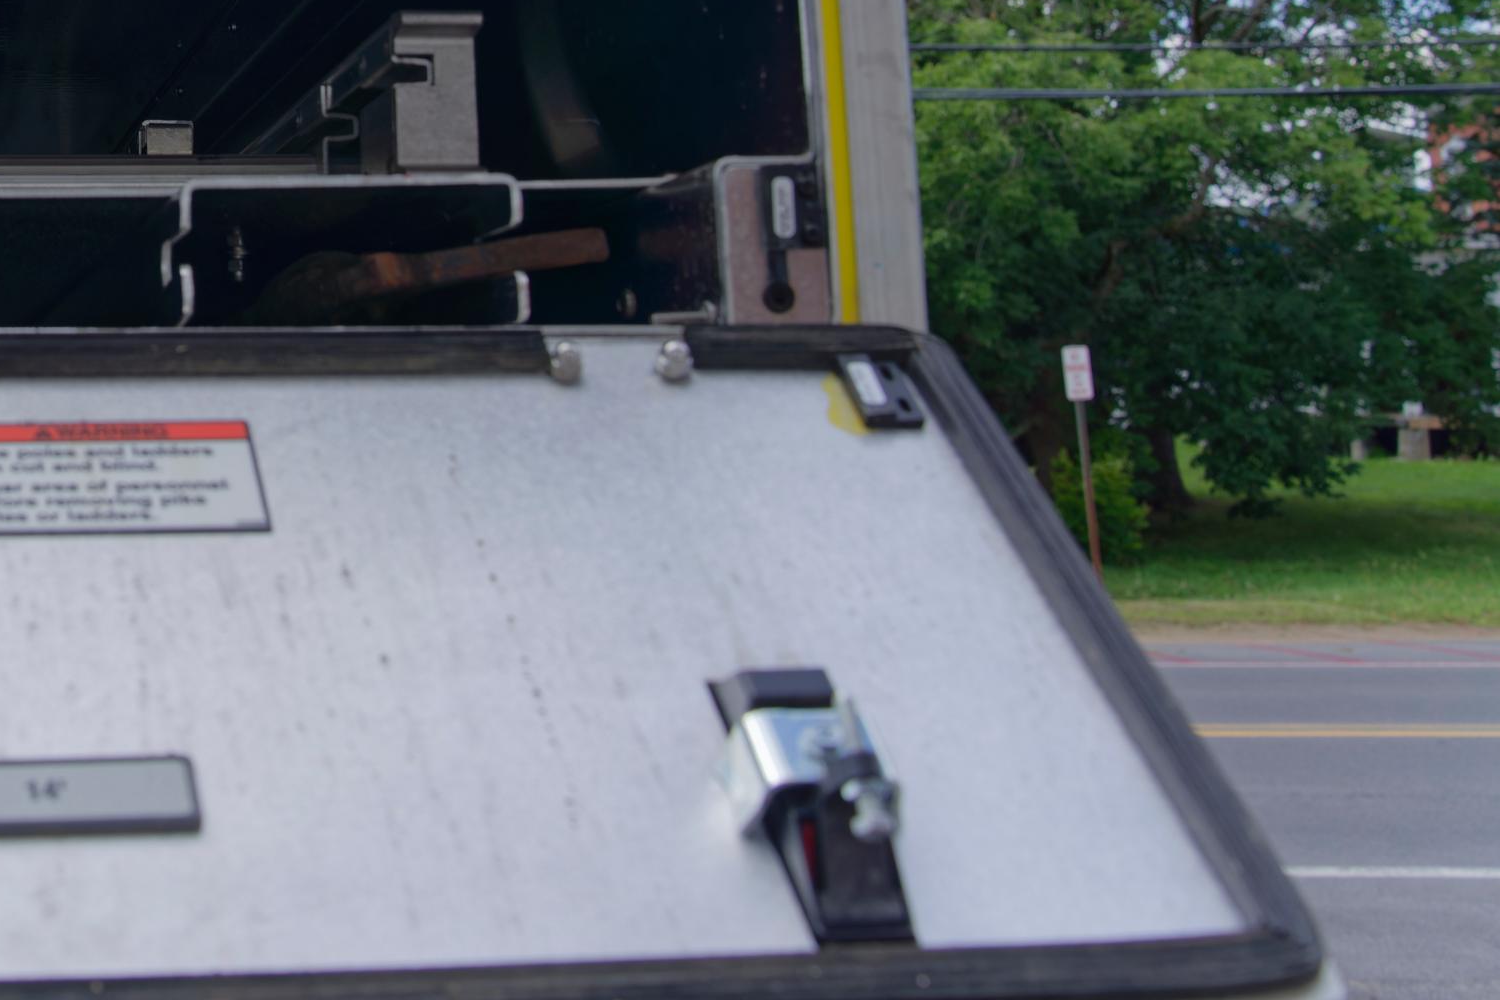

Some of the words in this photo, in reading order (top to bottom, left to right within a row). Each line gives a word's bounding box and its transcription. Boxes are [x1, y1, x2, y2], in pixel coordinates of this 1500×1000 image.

[17, 447, 76, 460] poles
[85, 446, 125, 457] and
[132, 445, 213, 457] ladders
[53, 461, 92, 472] and
[32, 482, 80, 492] area
[87, 480, 107, 491] of
[116, 479, 229, 494] personnel
[45, 495, 152, 508] removing
[161, 494, 207, 507] pike
[36, 513, 58, 521] or
